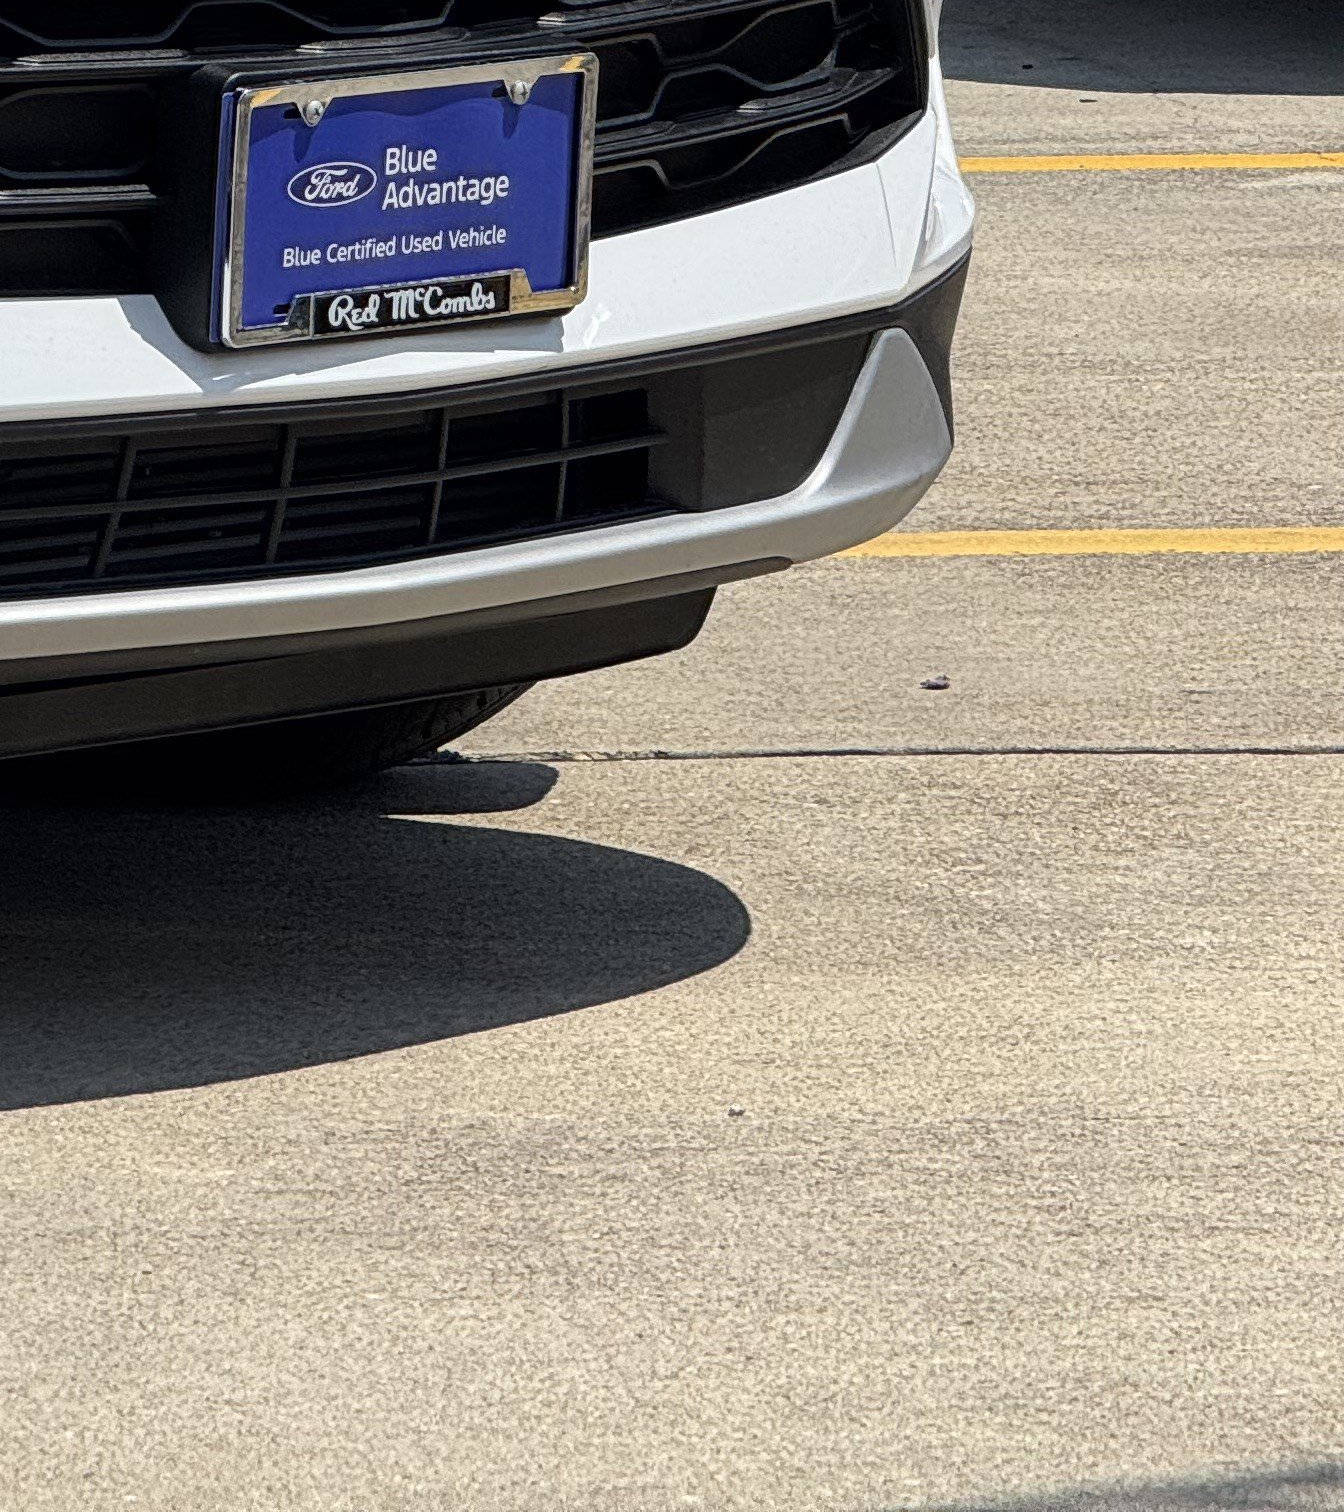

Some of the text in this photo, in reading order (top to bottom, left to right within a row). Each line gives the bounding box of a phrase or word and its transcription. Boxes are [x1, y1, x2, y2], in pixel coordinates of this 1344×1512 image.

[385, 144, 438, 176] Blue
[303, 168, 361, 201] Ford
[381, 173, 510, 211] Advantage
[283, 225, 508, 269] Blue Certified Used Vehicle
[328, 281, 496, 331] Red McCombs
